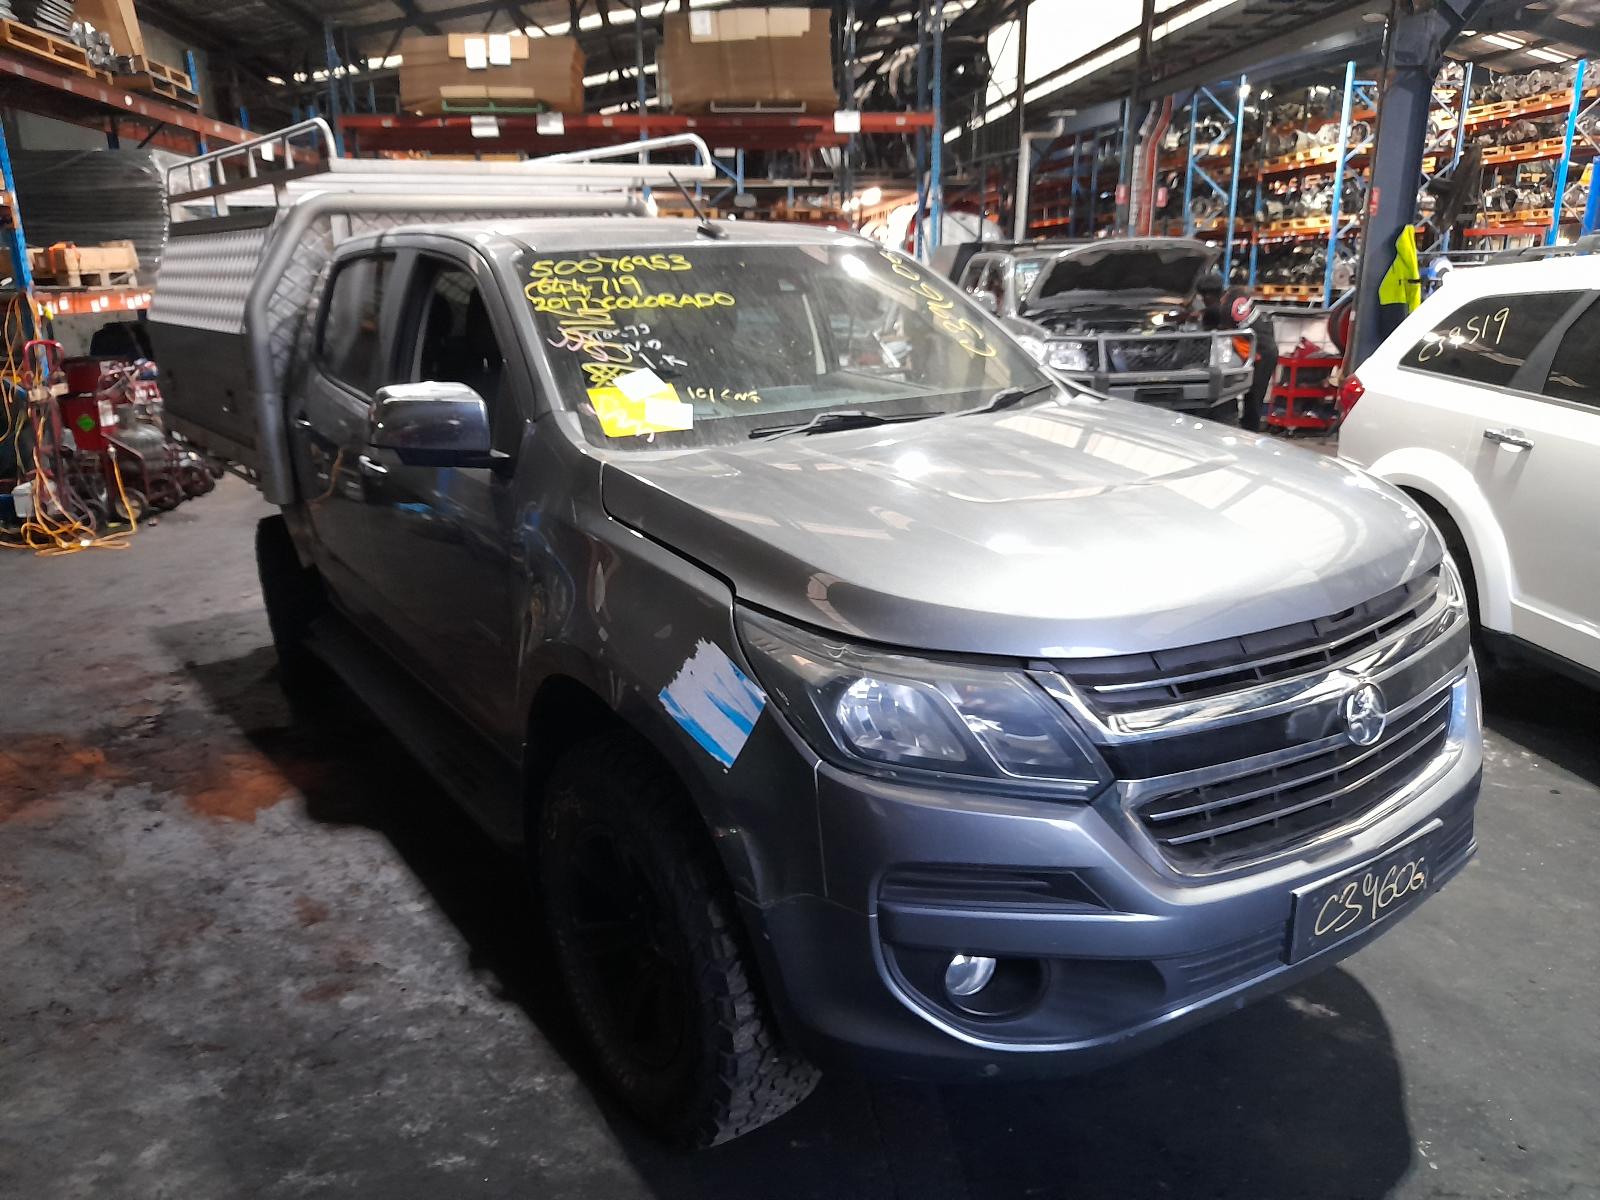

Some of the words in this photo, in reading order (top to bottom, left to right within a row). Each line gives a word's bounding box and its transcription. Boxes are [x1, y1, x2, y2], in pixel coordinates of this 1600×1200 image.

[529, 253, 693, 278] 50076953
[599, 291, 736, 311] COLORADO
[1314, 856, 1425, 936] C39606
